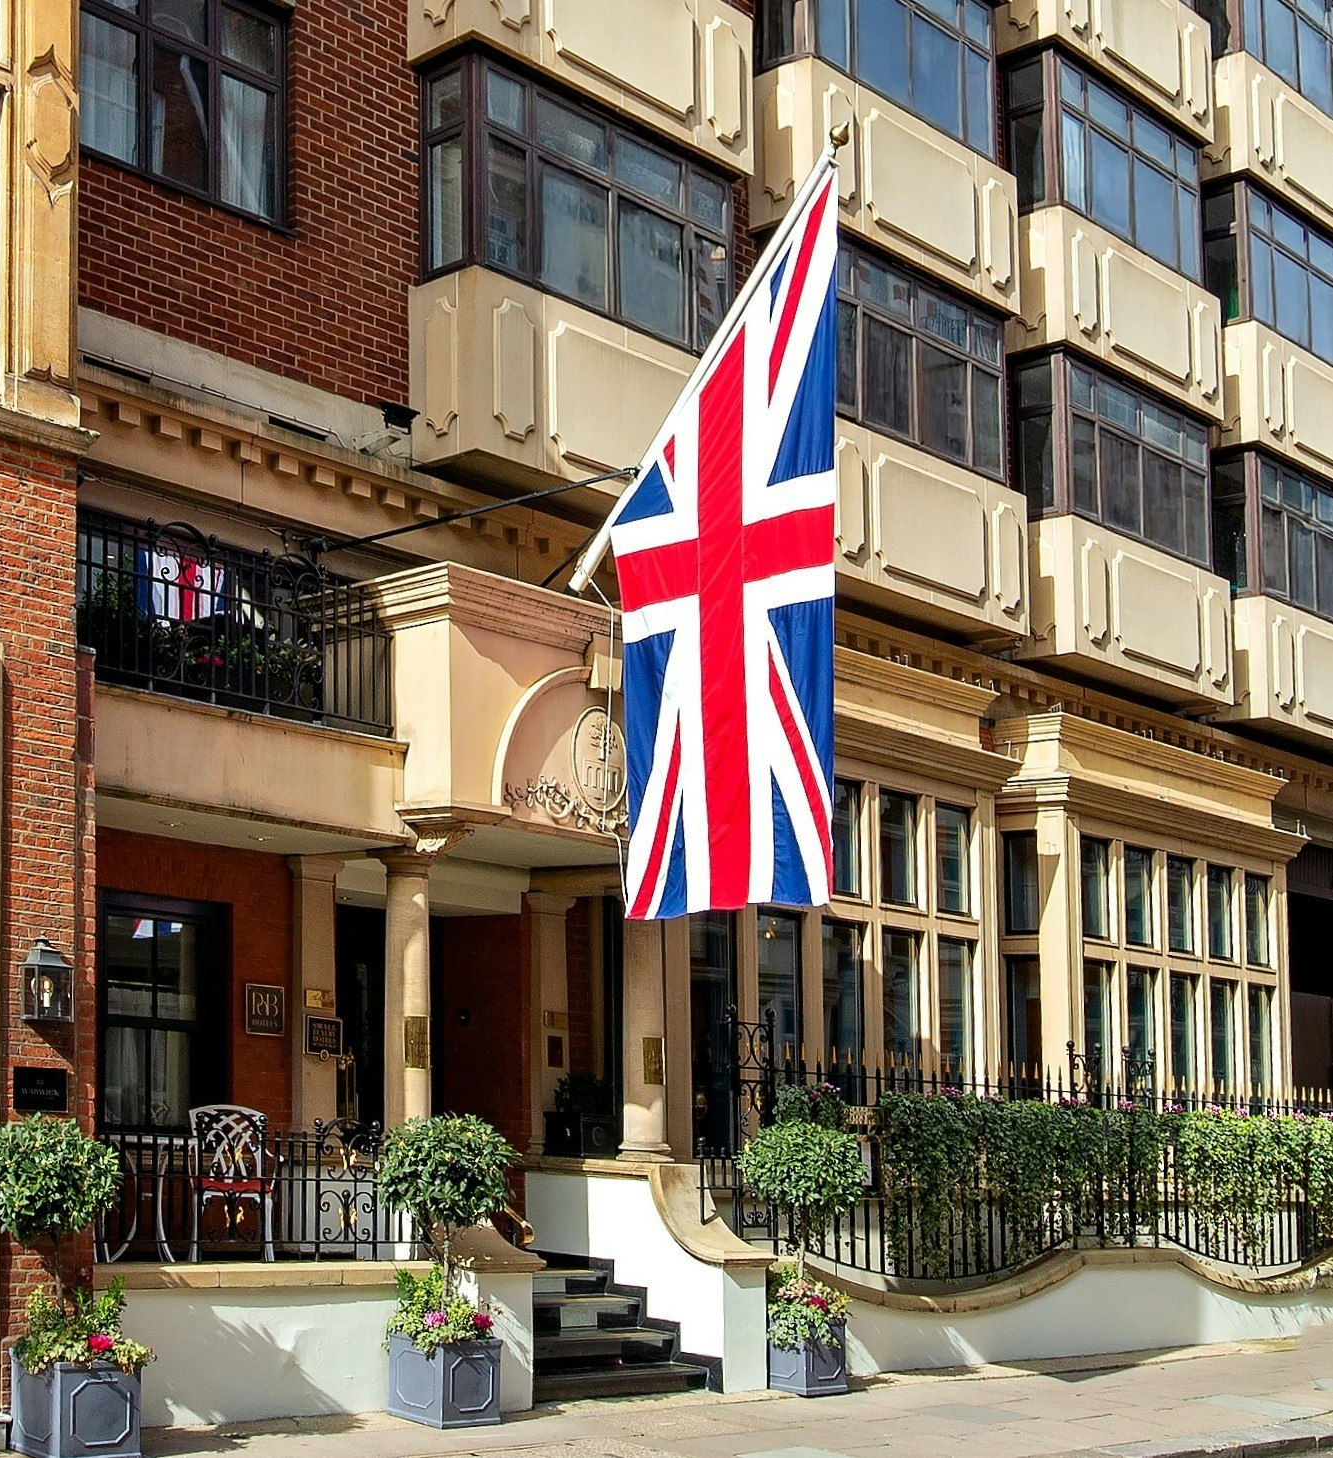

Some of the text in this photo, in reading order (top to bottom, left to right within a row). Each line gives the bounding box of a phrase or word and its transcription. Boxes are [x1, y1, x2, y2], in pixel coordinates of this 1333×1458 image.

[252, 1019, 278, 1028] HOTELS
[312, 1022, 337, 1031] SMALL
[312, 1028, 337, 1038] LUXURY
[312, 1035, 337, 1044] HOTELS
[21, 1087, 60, 1097] WARWICK
